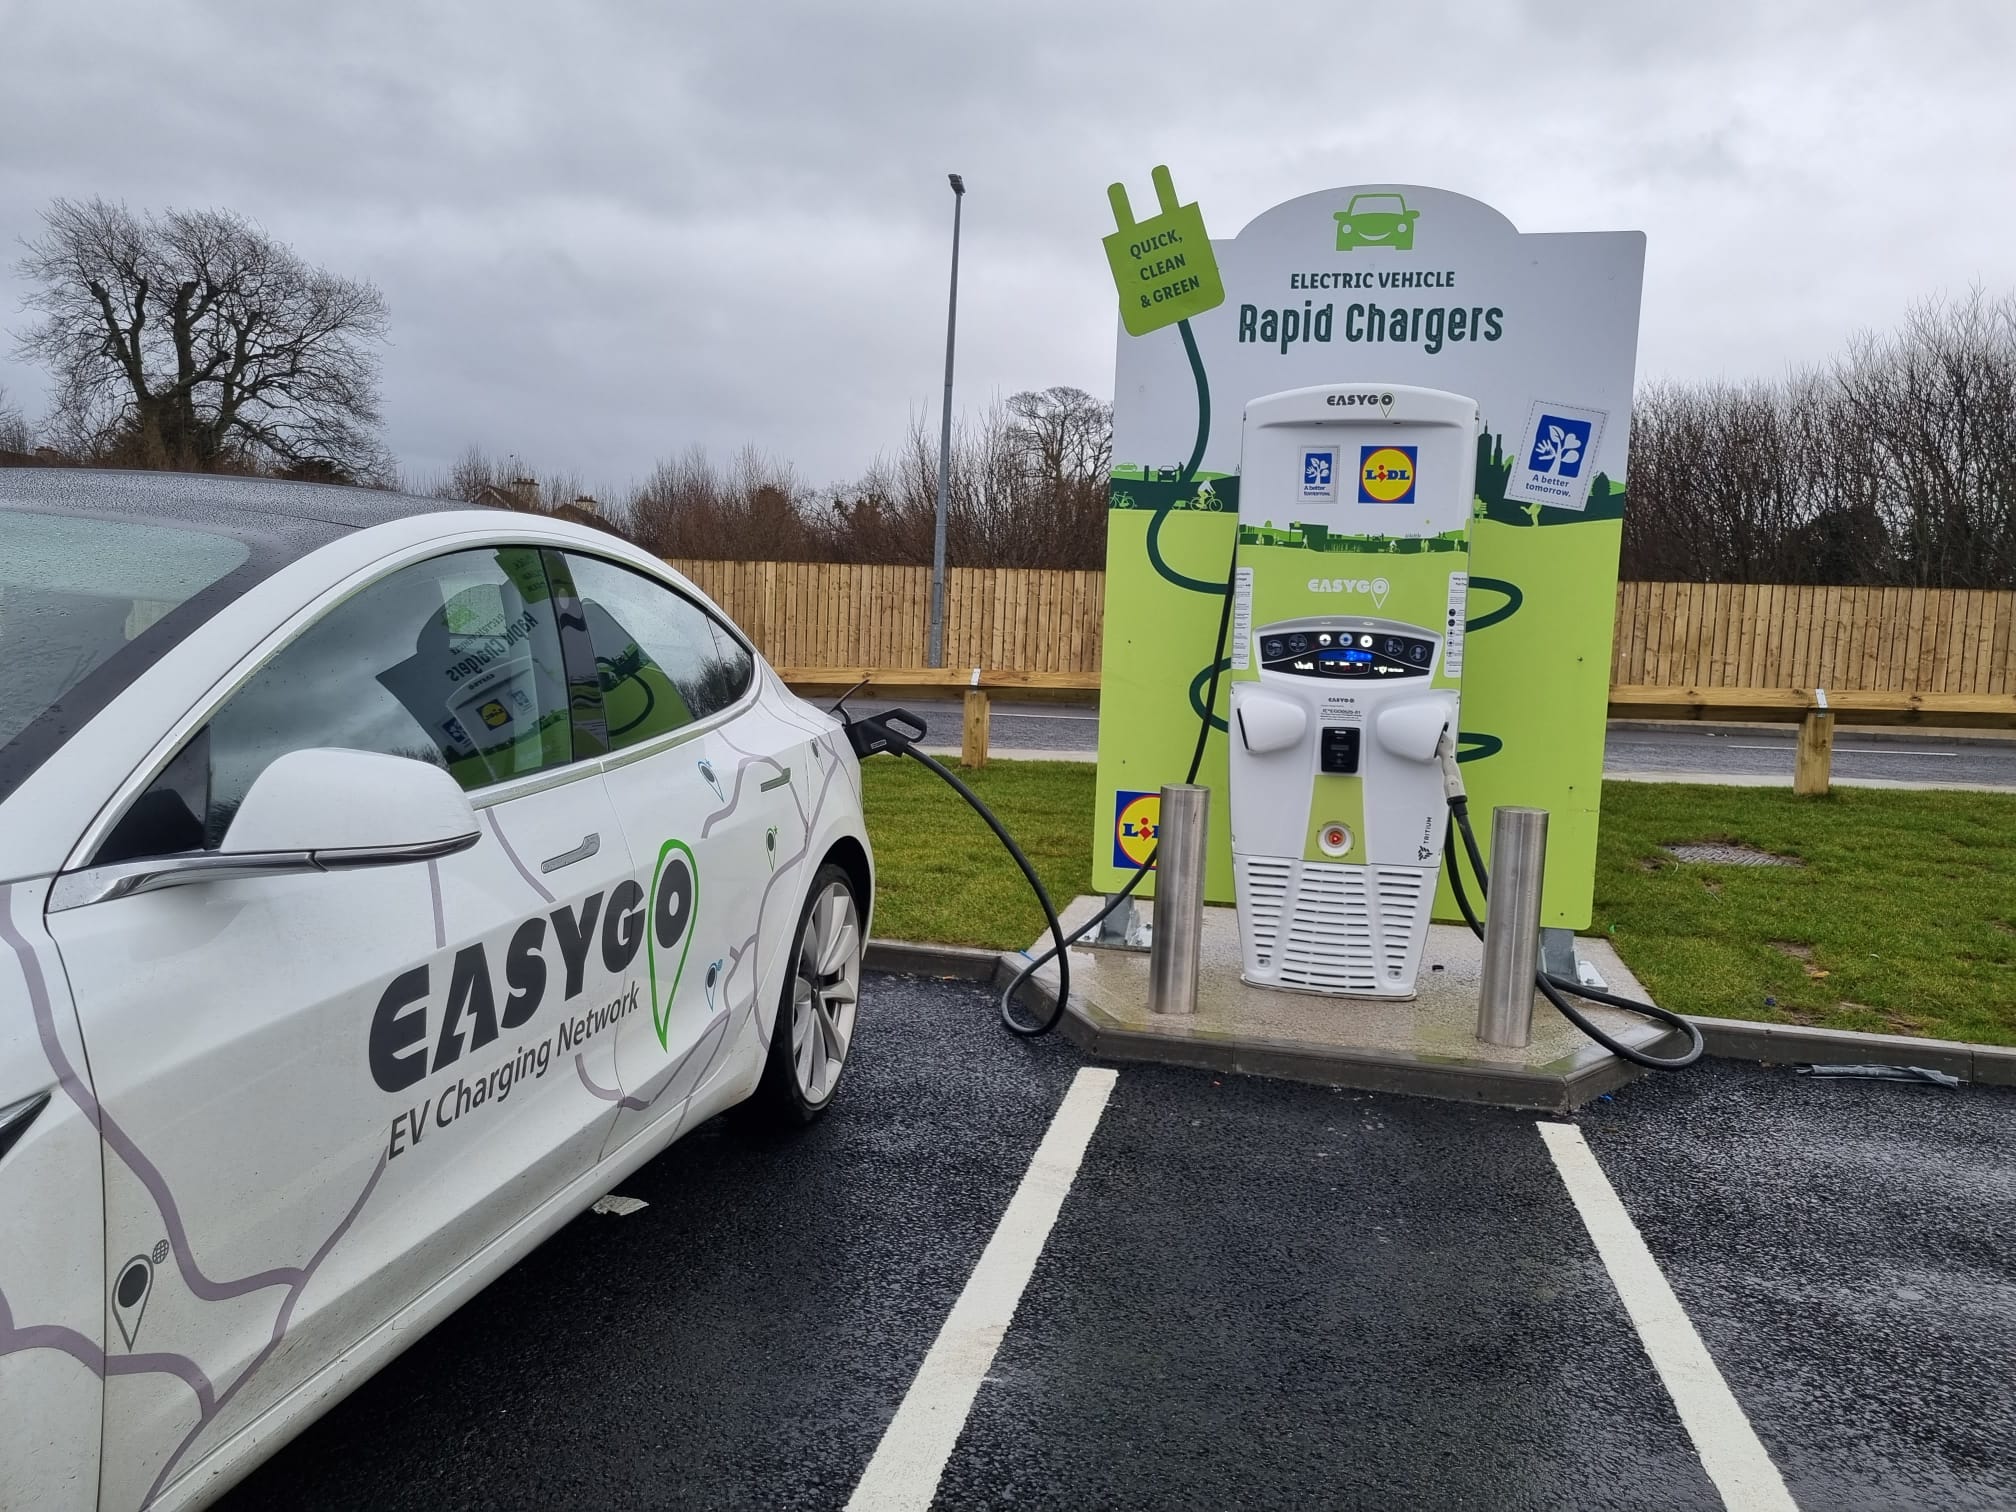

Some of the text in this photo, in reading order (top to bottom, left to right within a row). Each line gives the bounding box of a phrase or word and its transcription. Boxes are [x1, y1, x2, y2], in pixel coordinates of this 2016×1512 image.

[1130, 229, 1183, 259] QUICK,
[1140, 253, 1186, 281] CLEAN
[1290, 271, 1456, 289] ELECTRIC VEHICLE
[1140, 275, 1200, 308] & GREEN
[1238, 300, 1504, 355] Rapid Chargers
[1326, 393, 1395, 411] EASYGO
[1525, 482, 1572, 498] tomorrow.
[1541, 474, 1570, 488] better
[1307, 578, 1389, 599] EASYGO
[368, 846, 697, 1093] EASYGO
[388, 980, 641, 1161] EV Charging Network
